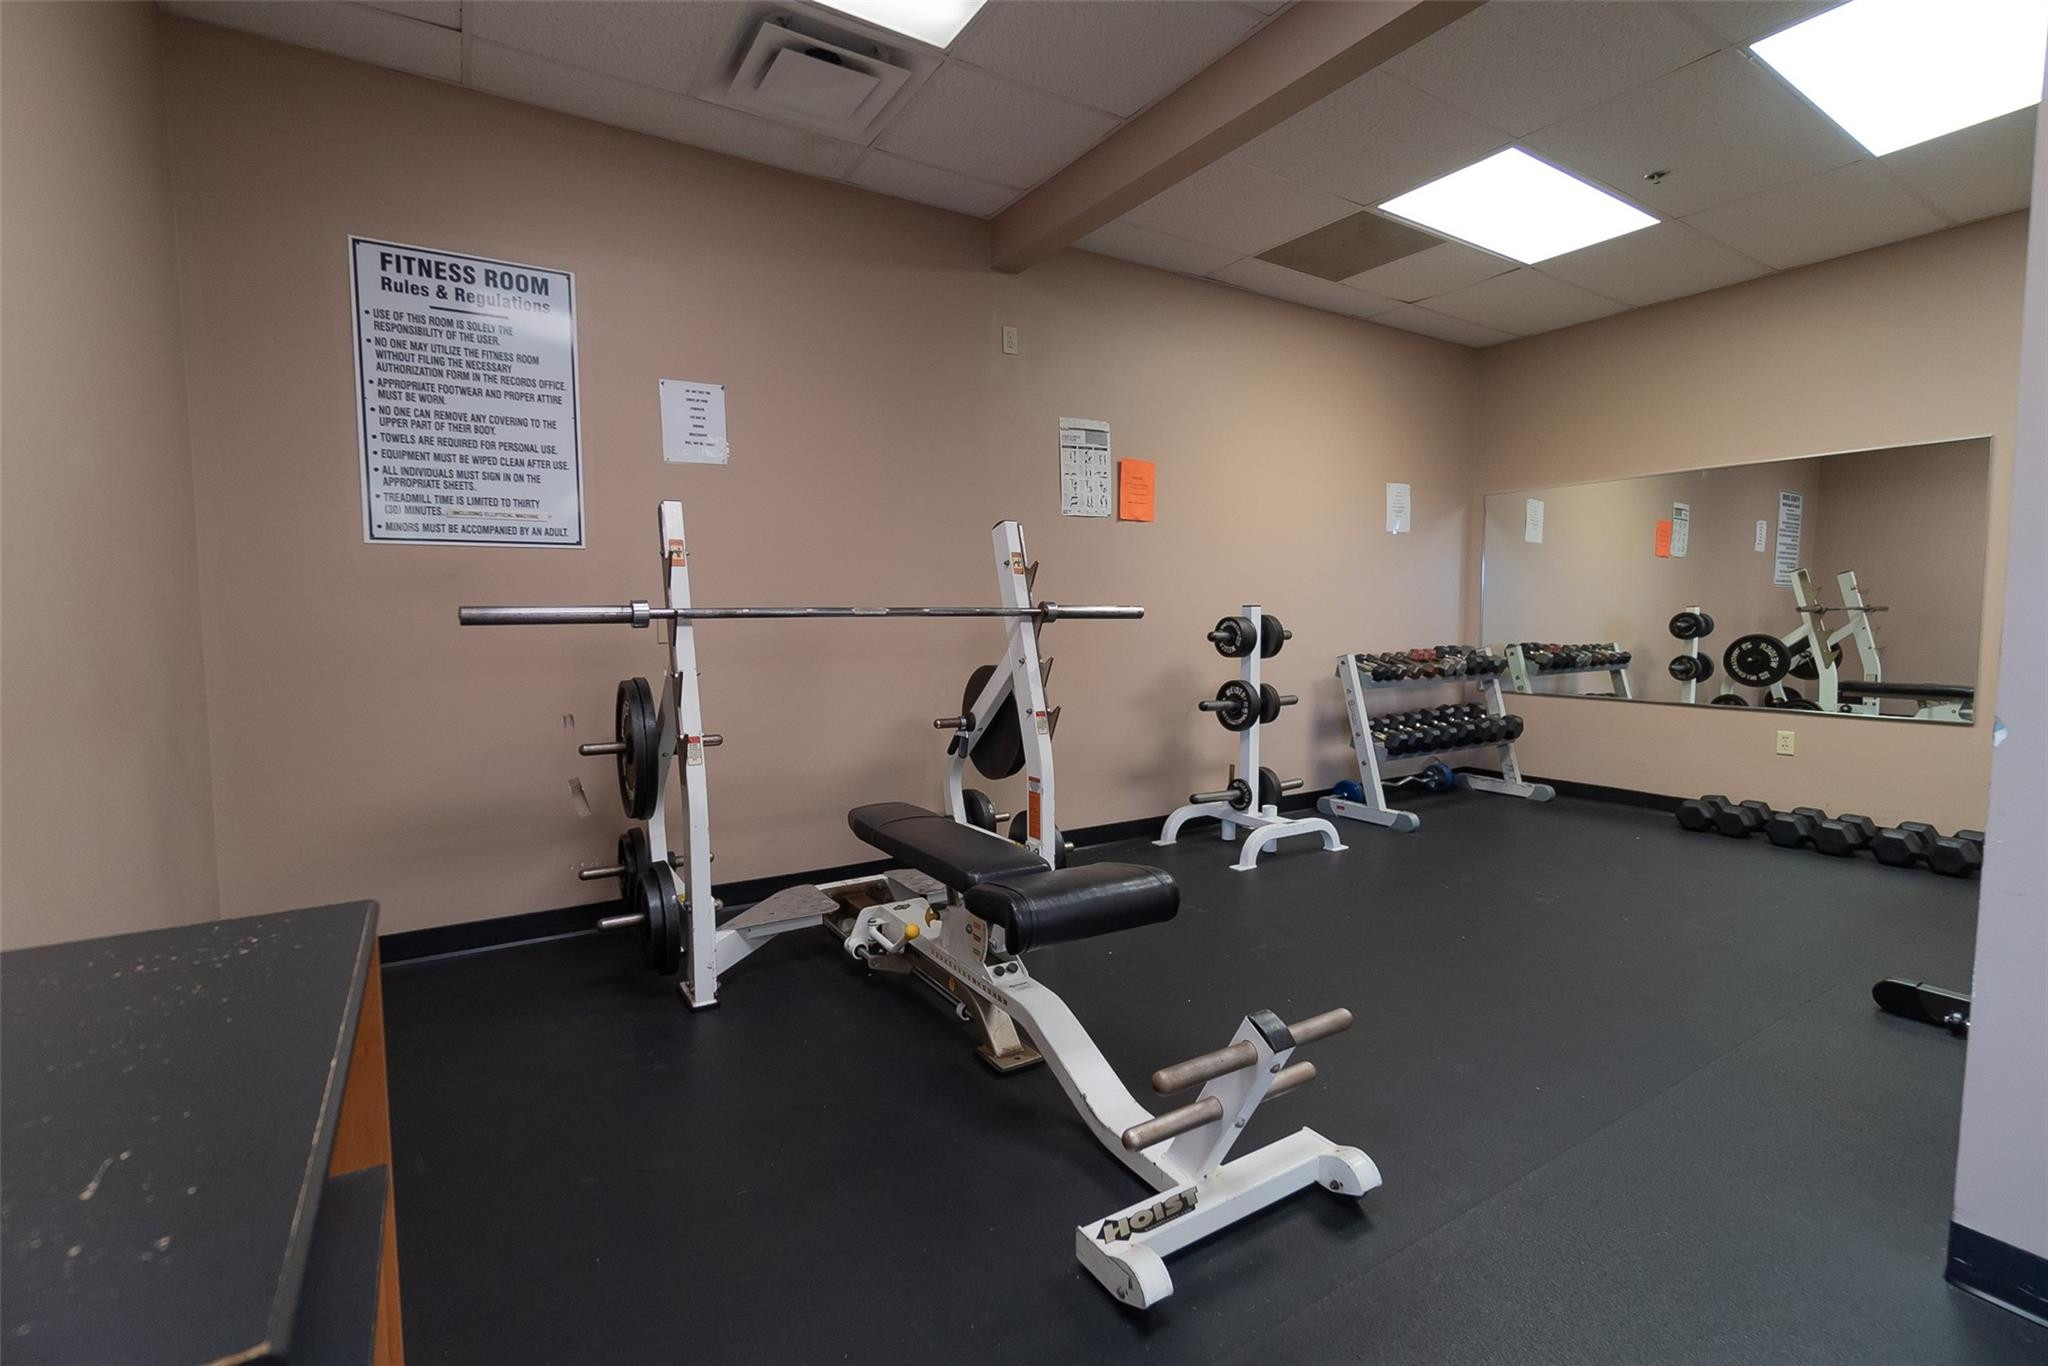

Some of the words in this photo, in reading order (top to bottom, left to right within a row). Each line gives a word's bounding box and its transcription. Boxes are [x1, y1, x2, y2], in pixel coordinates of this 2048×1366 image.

[380, 252, 476, 286] FITNESS
[485, 269, 549, 297] ROOM
[381, 276, 430, 297] Rules
[436, 285, 448, 300] &
[455, 287, 550, 315] Regulations
[373, 308, 391, 320] USE
[393, 311, 405, 322] OF
[407, 313, 426, 325] THIS
[429, 316, 454, 328] ROOM
[456, 320, 465, 330] IS
[466, 321, 495, 334] SOLELY
[499, 325, 513, 336] THE
[374, 321, 443, 339] RESPONSIBILITY
[446, 330, 457, 341] OF
[459, 332, 475, 343] THE
[477, 334, 500, 346] USER.
[374, 337, 388, 348] NO
[390, 339, 407, 350] ONE
[410, 341, 428, 352] MAY
[431, 344, 461, 356] UTILIZE
[464, 348, 479, 358] THE
[482, 350, 514, 362] FITNESS
[516, 354, 539, 365] ROOM
[375, 349, 415, 363] WITHOUT
[418, 354, 445, 366] FILING
[448, 358, 463, 368] THE
[465, 360, 512, 374] NECESSARY
[376, 362, 444, 379] AUTHORIZATION
[447, 369, 470, 381] FORM
[473, 372, 481, 382] IN
[483, 373, 498, 384] THE
[500, 375, 537, 388] RECORDS
[539, 380, 567, 391] OFFICE.
[377, 378, 435, 393] APPROPRIATE
[438, 384, 484, 397] FOOTWEAR
[485, 389, 502, 399] AND
[504, 391, 535, 402] PROPER
[537, 394, 563, 405] ATTIRE
[378, 390, 403, 401] MUST
[406, 392, 416, 402] BE
[419, 394, 447, 405] WORN.
[379, 405, 392, 416] NO
[394, 407, 411, 417] ONE
[414, 408, 431, 419] CAN
[434, 410, 468, 422] REMOVE
[470, 414, 487, 424] ANY
[489, 415, 528, 427] COVERING
[531, 419, 541, 428] TO
[543, 420, 557, 430] THE
[379, 417, 408, 429] UPPER
[411, 420, 432, 430] PART
[435, 422, 446, 431] OF
[448, 423, 472, 434] THEIR
[474, 425, 496, 435] BODY.
[380, 433, 416, 445] TOWELS
[418, 436, 434, 446] ARE
[437, 437, 477, 449] REQUIRED
[480, 440, 496, 450] FOR
[498, 442, 539, 453] PERSONAL
[541, 445, 558, 455] USE.
[381, 449, 431, 462] EQUIPMENT
[433, 453, 457, 464] MUST
[459, 455, 470, 464] BE
[472, 455, 497, 466] WIPED
[500, 457, 525, 468] CLEAN
[527, 459, 551, 470] AFTER
[552, 461, 570, 471] USE.
[382, 466, 397, 476] ALL
[401, 467, 454, 479] INDIVIDUALS
[457, 470, 479, 480] MUST
[482, 472, 501, 482] SIGN
[503, 473, 511, 482] IN
[513, 473, 525, 483] ON
[527, 474, 541, 484] THE
[383, 477, 441, 489] APPROPRIATE
[443, 481, 477, 491] SHEETS.
[384, 493, 431, 504] TREADMILL
[434, 495, 454, 505] TIME
[456, 496, 464, 505] IS
[467, 497, 499, 507] LIMITED
[501, 498, 511, 507] TO
[513, 499, 540, 509] THIRTY
[385, 505, 402, 515] (30)
[404, 506, 445, 517] MINUTES.
[385, 522, 420, 533] MINORS
[422, 524, 446, 534] MUST
[448, 524, 458, 534] BE
[461, 525, 517, 536] ACCOMPANIED
[520, 527, 530, 536] BY
[532, 527, 542, 536] AN
[544, 528, 568, 537] ADULT.
[1103, 1186, 1199, 1245] HOIST
